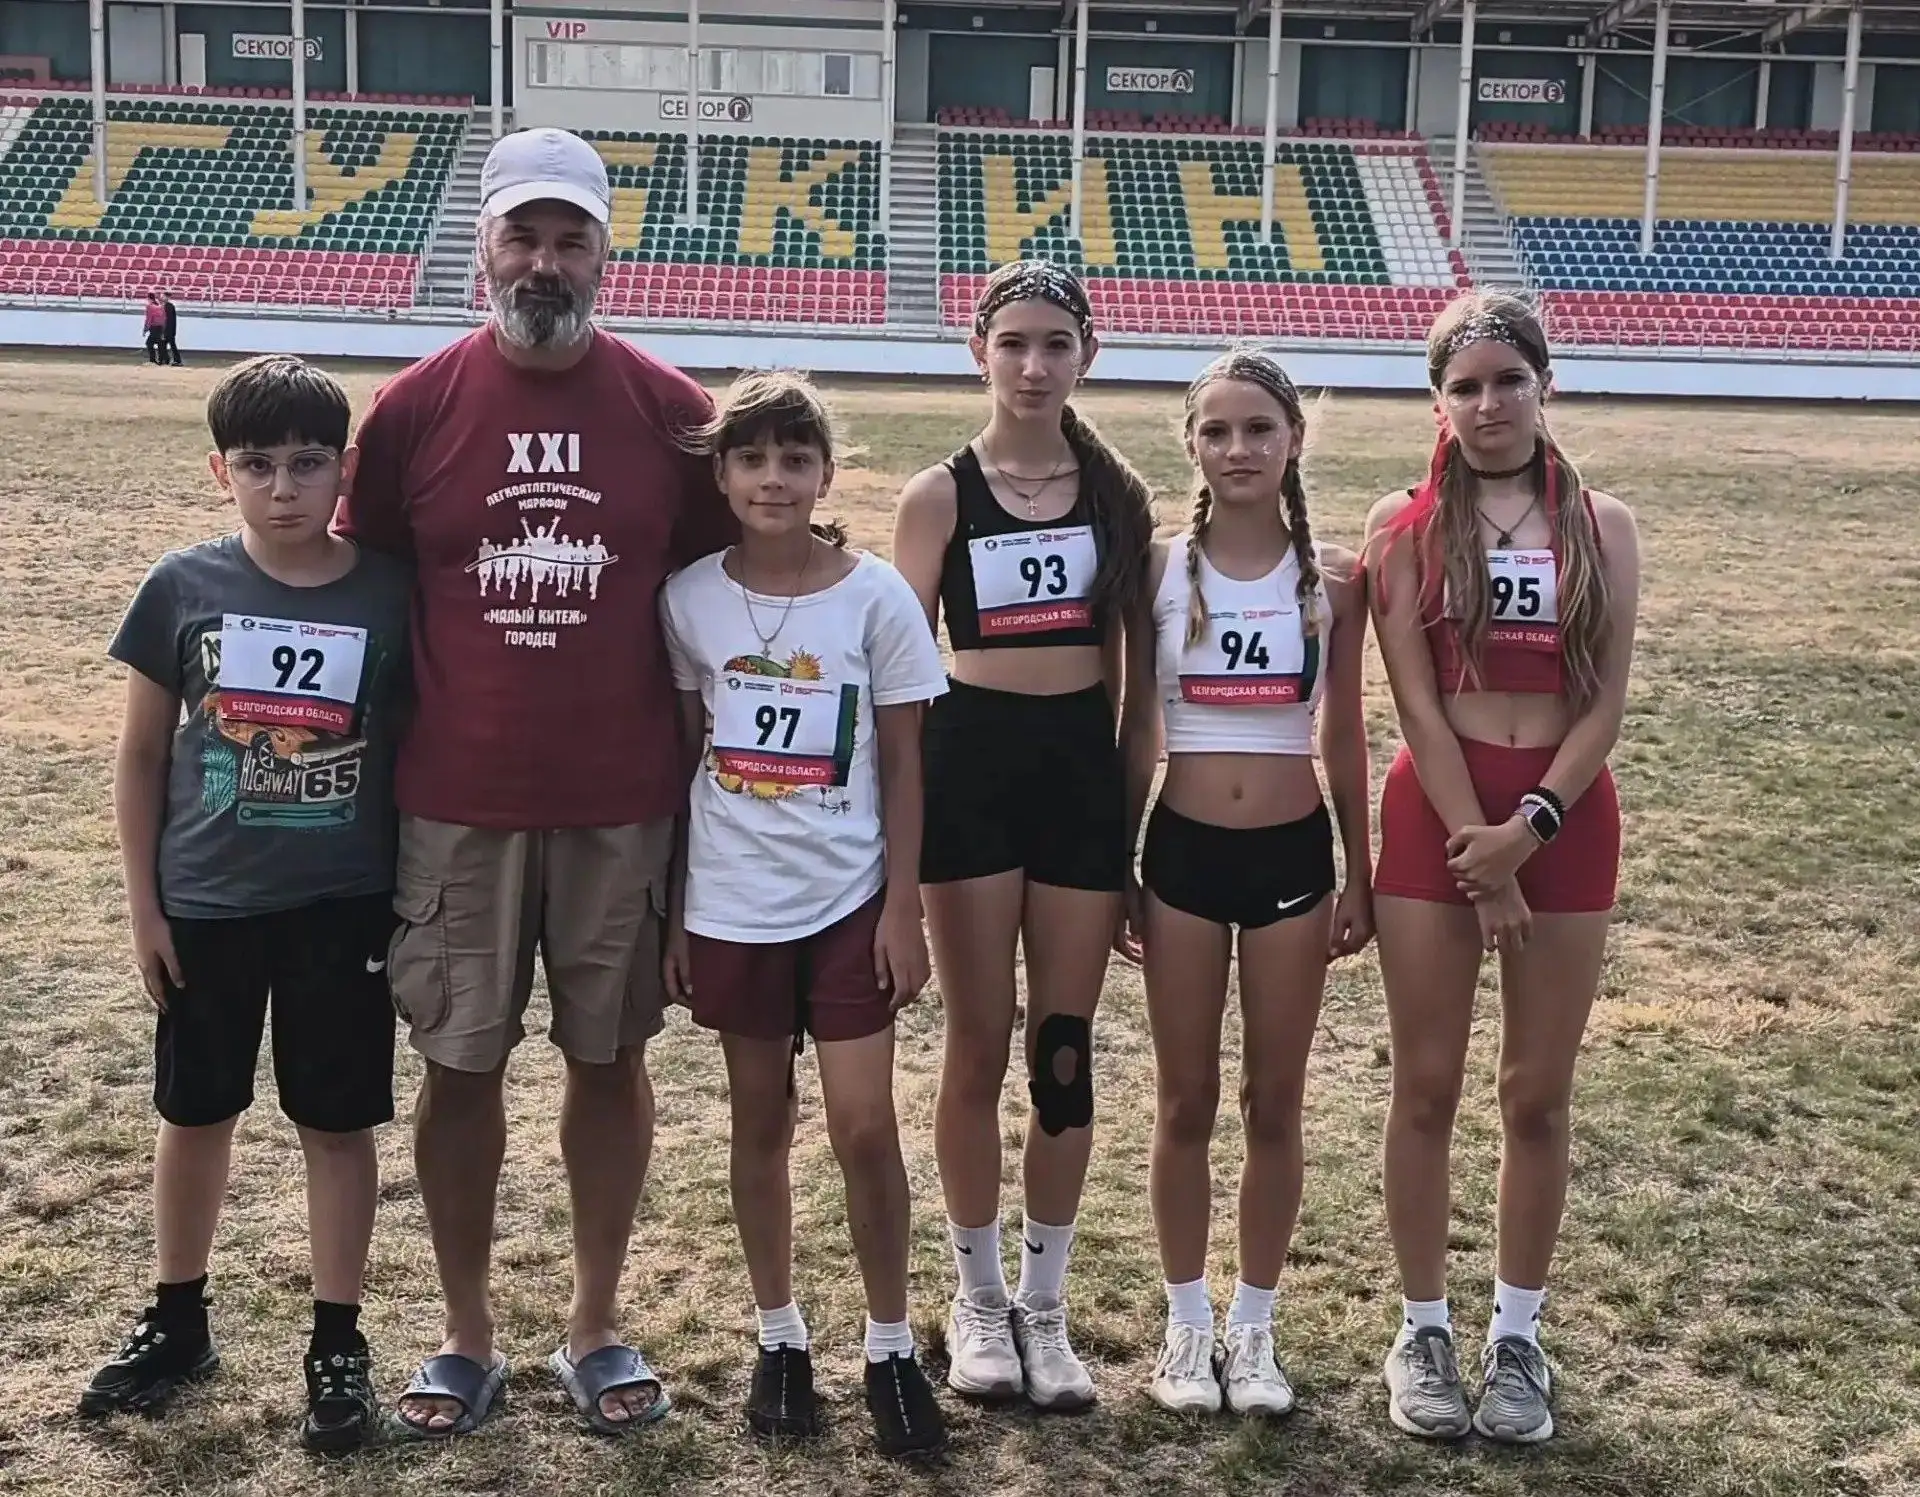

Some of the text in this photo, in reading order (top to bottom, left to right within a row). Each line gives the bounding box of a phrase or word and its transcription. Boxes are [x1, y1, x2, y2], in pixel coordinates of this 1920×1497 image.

[546, 21, 586, 38] VIP
[1109, 72, 1169, 89] СЕКТОР
[1480, 83, 1540, 99] СЕКТОР
[507, 433, 580, 473] XXI
[486, 481, 601, 506] ЛЕГКОАТЛЕТИЧЕСКИЙ
[518, 497, 568, 511] МАРАФОН
[1020, 554, 1068, 598] 93
[1492, 576, 1541, 617] 95
[505, 630, 557, 648] ГОРОДЕЦ
[1221, 631, 1270, 670] 94
[272, 645, 325, 691] 92
[231, 701, 344, 724] БЕЛГОРОДСКАЯ ОБЛАСТЬ
[755, 705, 801, 749] 97
[240, 750, 359, 800] HIGHWAY 65
